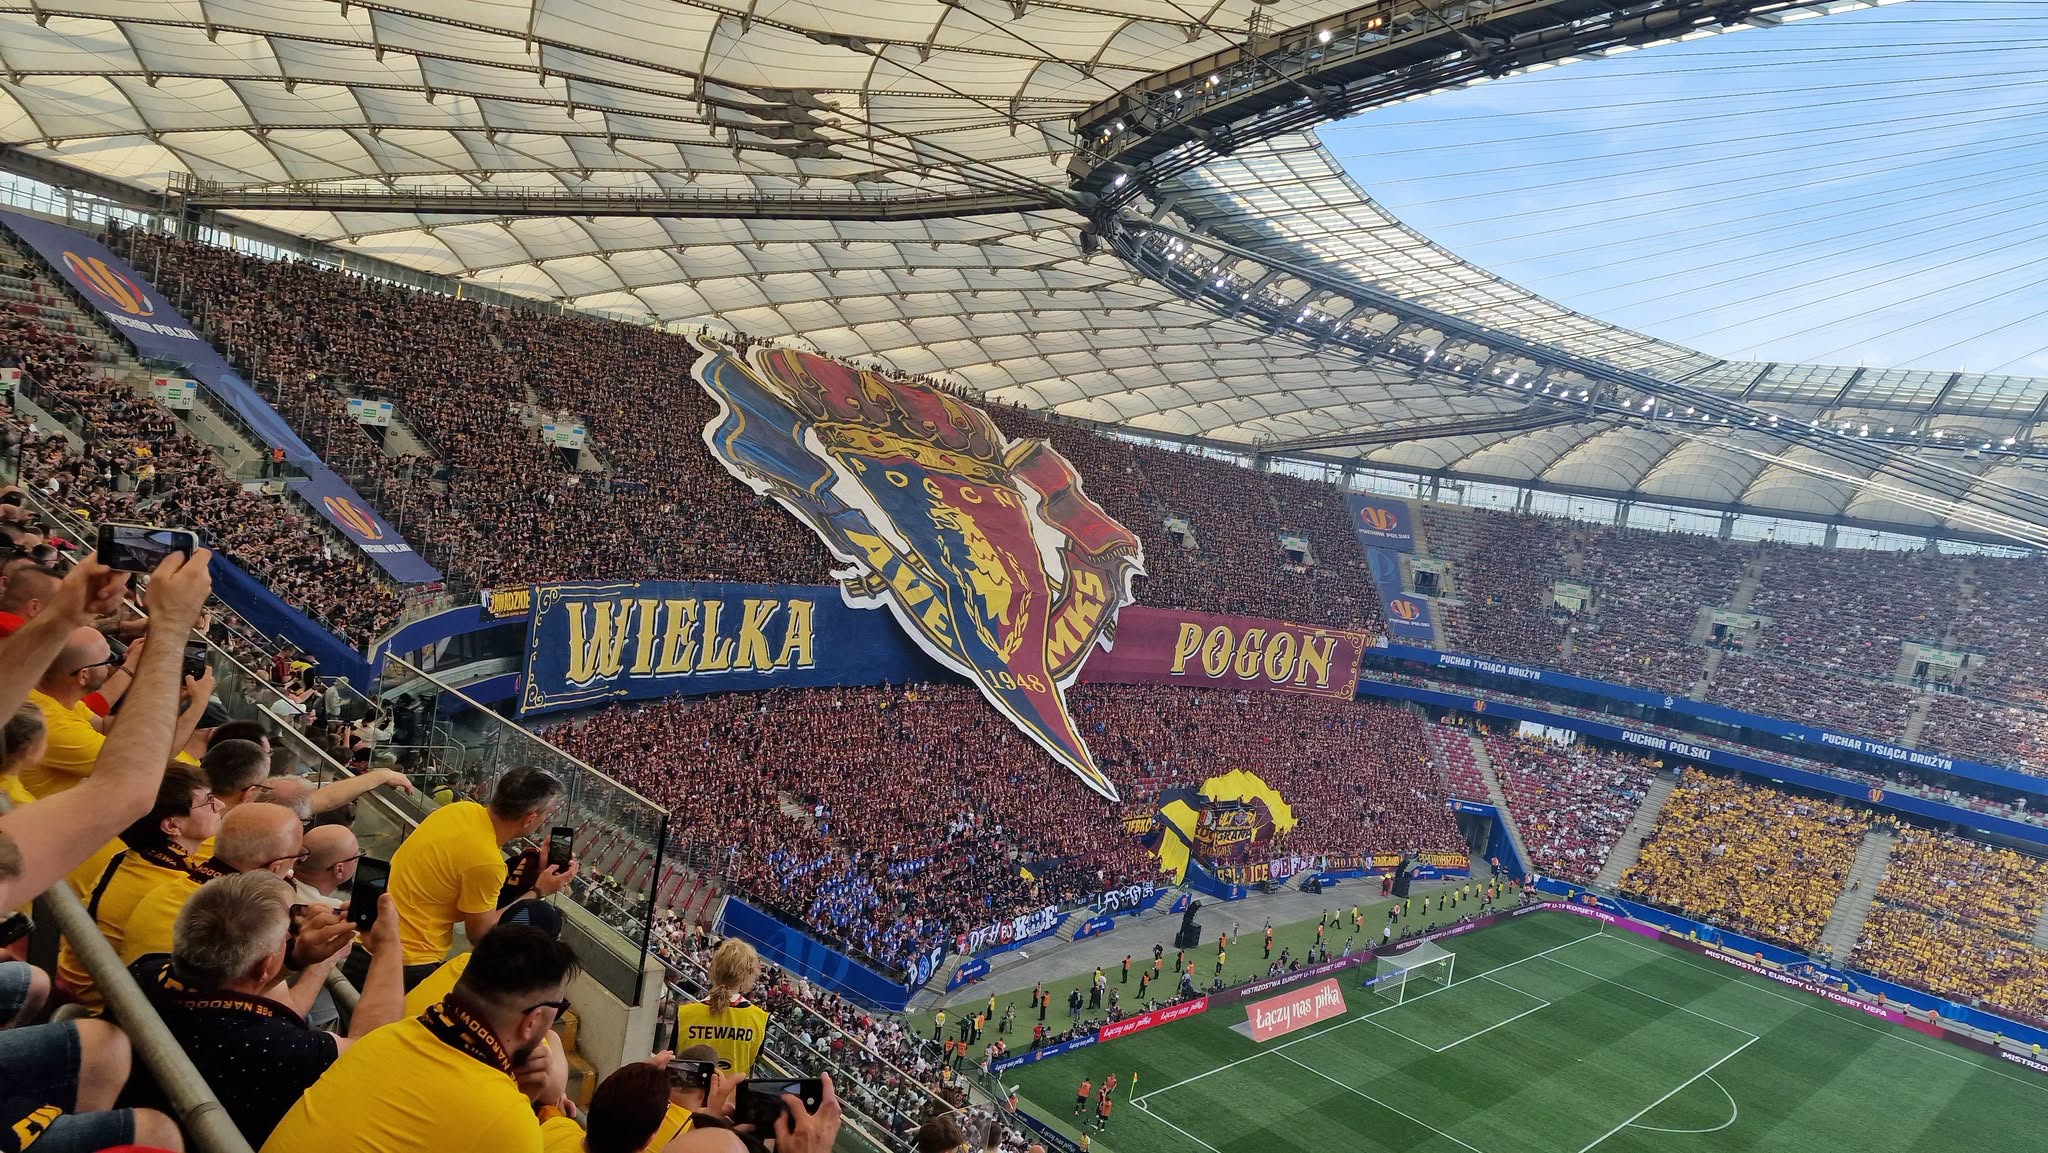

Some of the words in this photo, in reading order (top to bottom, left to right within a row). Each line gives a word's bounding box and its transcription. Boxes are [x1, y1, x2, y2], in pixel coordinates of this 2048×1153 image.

[843, 527, 953, 648] AVE
[1049, 569, 1106, 669] MKS
[565, 597, 817, 688] WIELKA
[985, 669, 1047, 693] 1948
[1440, 654, 1471, 667] PUCHAR
[1473, 660, 1506, 674] TYSIĄCA
[1508, 667, 1541, 680] DRUŻYN
[1621, 730, 1667, 750] PUCHAR
[1669, 741, 1712, 761] POLSKI
[1822, 732, 1863, 750] PUCHAR
[1865, 742, 1908, 760] TYSIĄCA
[1910, 754, 1953, 771] DRUŻYN
[1240, 979, 1281, 997] MISTRZOSTWA
[1282, 973, 1303, 985] EUROPY
[1303, 969, 1316, 978] U-19
[1704, 949, 1767, 976] MISTRZOSTWA
[1768, 971, 1804, 988] EUROPY
[1805, 985, 1826, 996] U-19
[1828, 992, 1862, 1008] KOBIET
[1863, 1004, 1887, 1017] UEFA
[1103, 1024, 1124, 1037] Łączy
[1160, 1011, 1179, 1021] Łączy
[1256, 1008, 1290, 1032] Łączy
[1292, 998, 1312, 1018] nas
[1315, 985, 1340, 1019] piłka
[688, 1025, 753, 1042] STEWARD
[2002, 1051, 2048, 1072] MISTRZO
